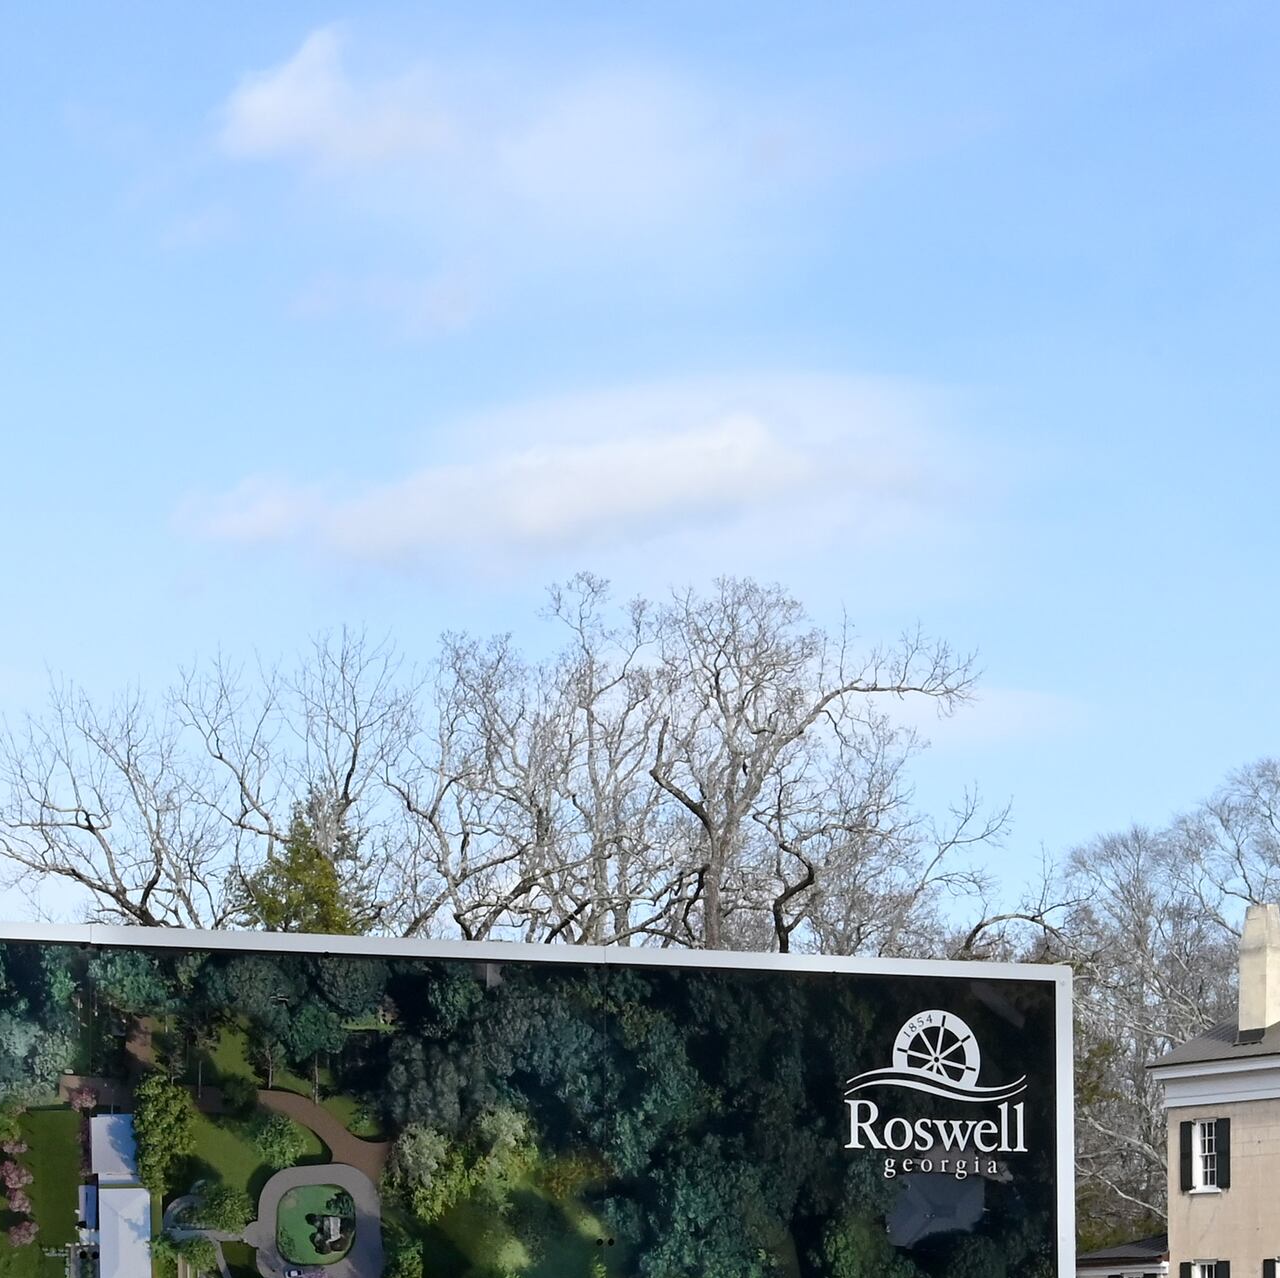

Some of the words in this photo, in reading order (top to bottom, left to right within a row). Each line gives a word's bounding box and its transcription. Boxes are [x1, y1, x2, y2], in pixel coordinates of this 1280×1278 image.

[903, 1014, 932, 1038] 1854
[843, 1098, 1029, 1153] Roswell
[883, 1156, 998, 1179] georgia
